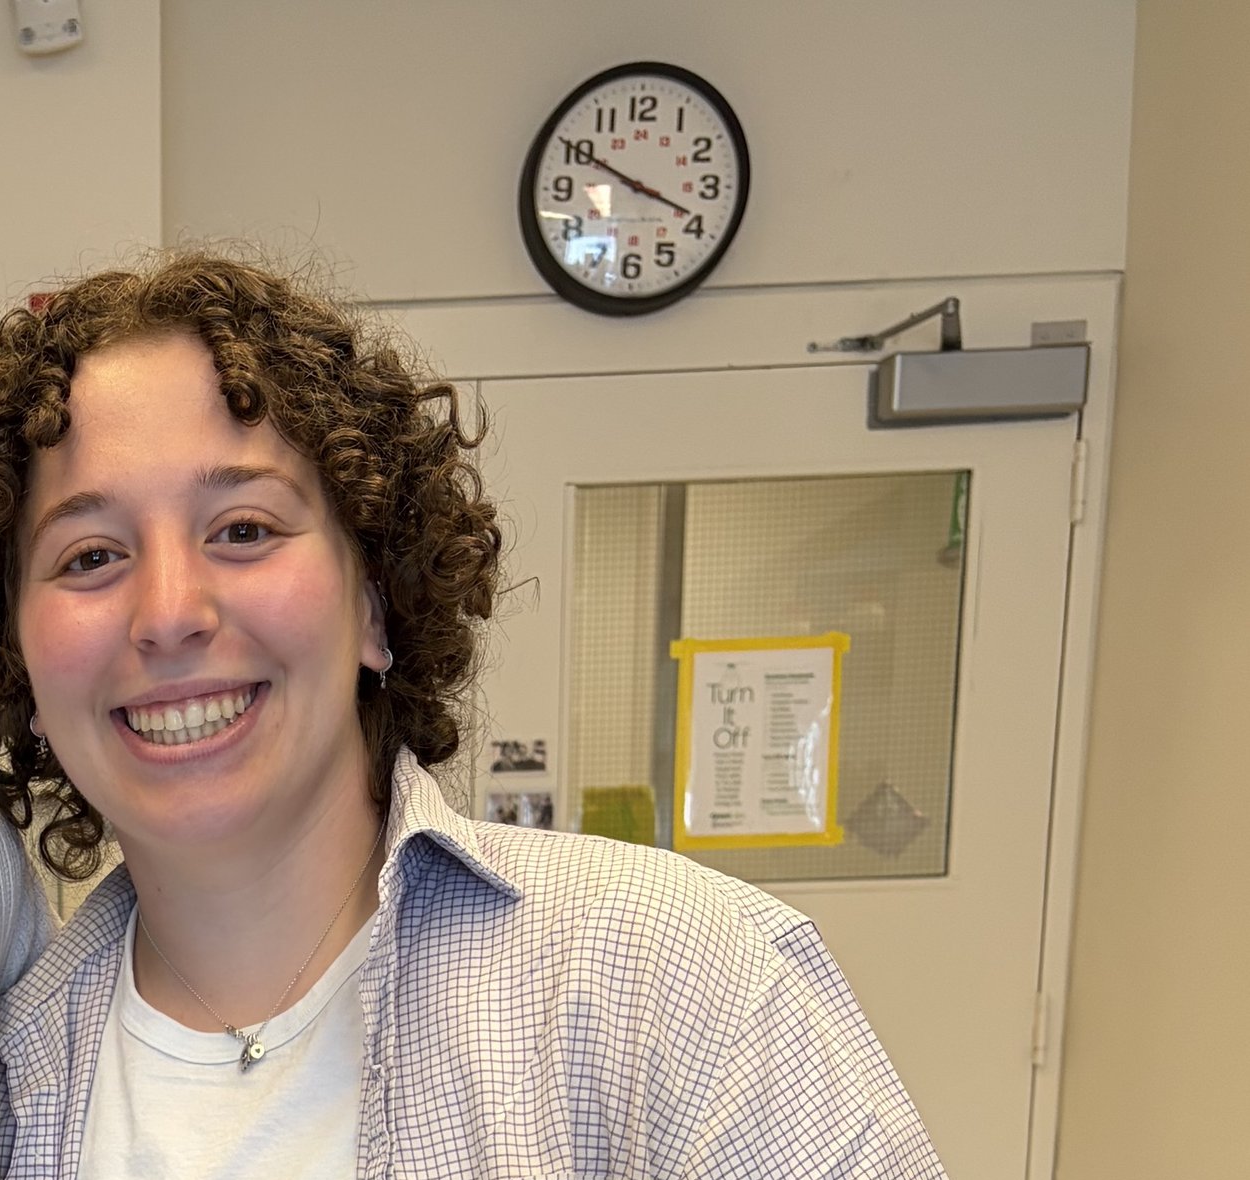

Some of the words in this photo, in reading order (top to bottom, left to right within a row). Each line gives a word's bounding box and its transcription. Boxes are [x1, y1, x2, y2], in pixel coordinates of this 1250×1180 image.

[595, 107, 617, 134] 11
[628, 95, 658, 122] 12
[676, 107, 684, 133] 1
[563, 139, 594, 165] 10
[692, 137, 713, 163] 2
[552, 175, 573, 202] 9
[699, 174, 720, 200] 3
[562, 215, 583, 242] 8
[682, 215, 705, 240] 4
[586, 243, 608, 268] 7
[621, 254, 643, 279] 6
[654, 242, 676, 268] 5
[707, 682, 755, 704] Turn
[723, 706, 735, 726] It
[712, 727, 751, 749] Off
